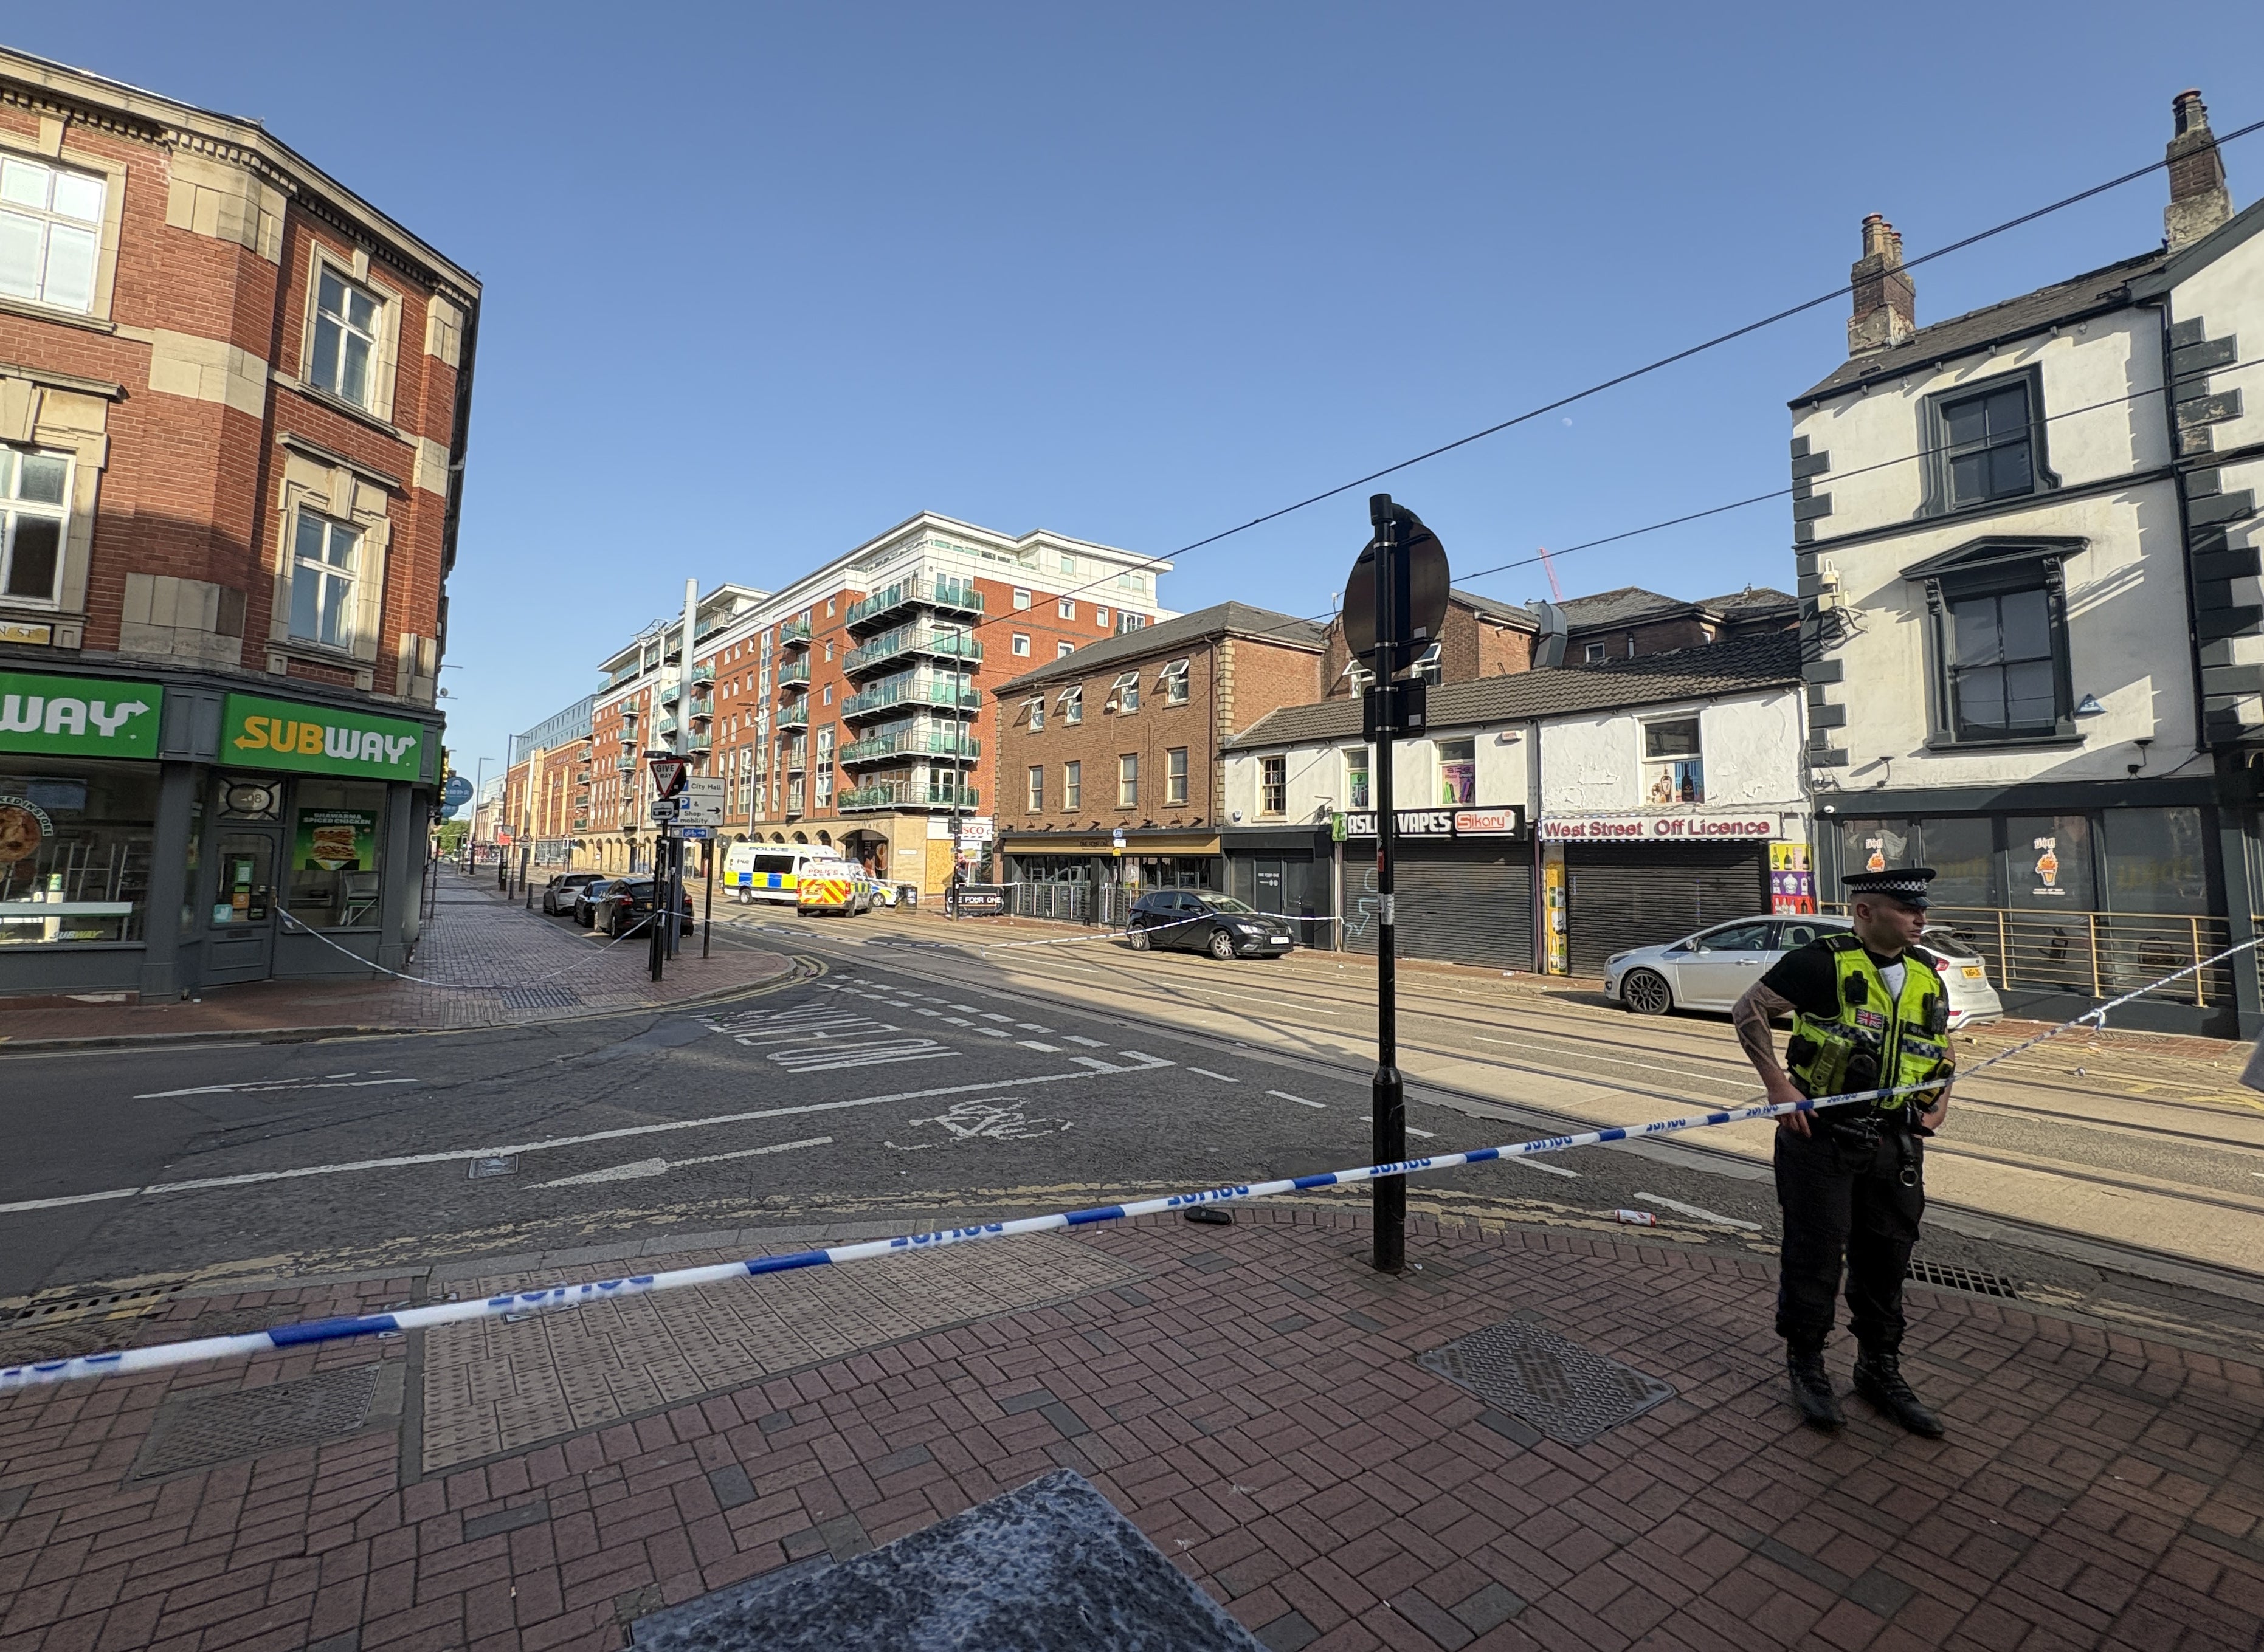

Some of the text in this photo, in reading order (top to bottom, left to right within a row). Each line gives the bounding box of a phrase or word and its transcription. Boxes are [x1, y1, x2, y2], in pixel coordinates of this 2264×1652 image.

[17, 628, 35, 638] ST
[233, 716, 418, 765] SUBWAY
[34, 808, 52, 835] STORE
[1397, 812, 1452, 833] VAPES
[1544, 819, 1770, 836] West Street Off Licence
[49, 930, 105, 939] SUBWAY
